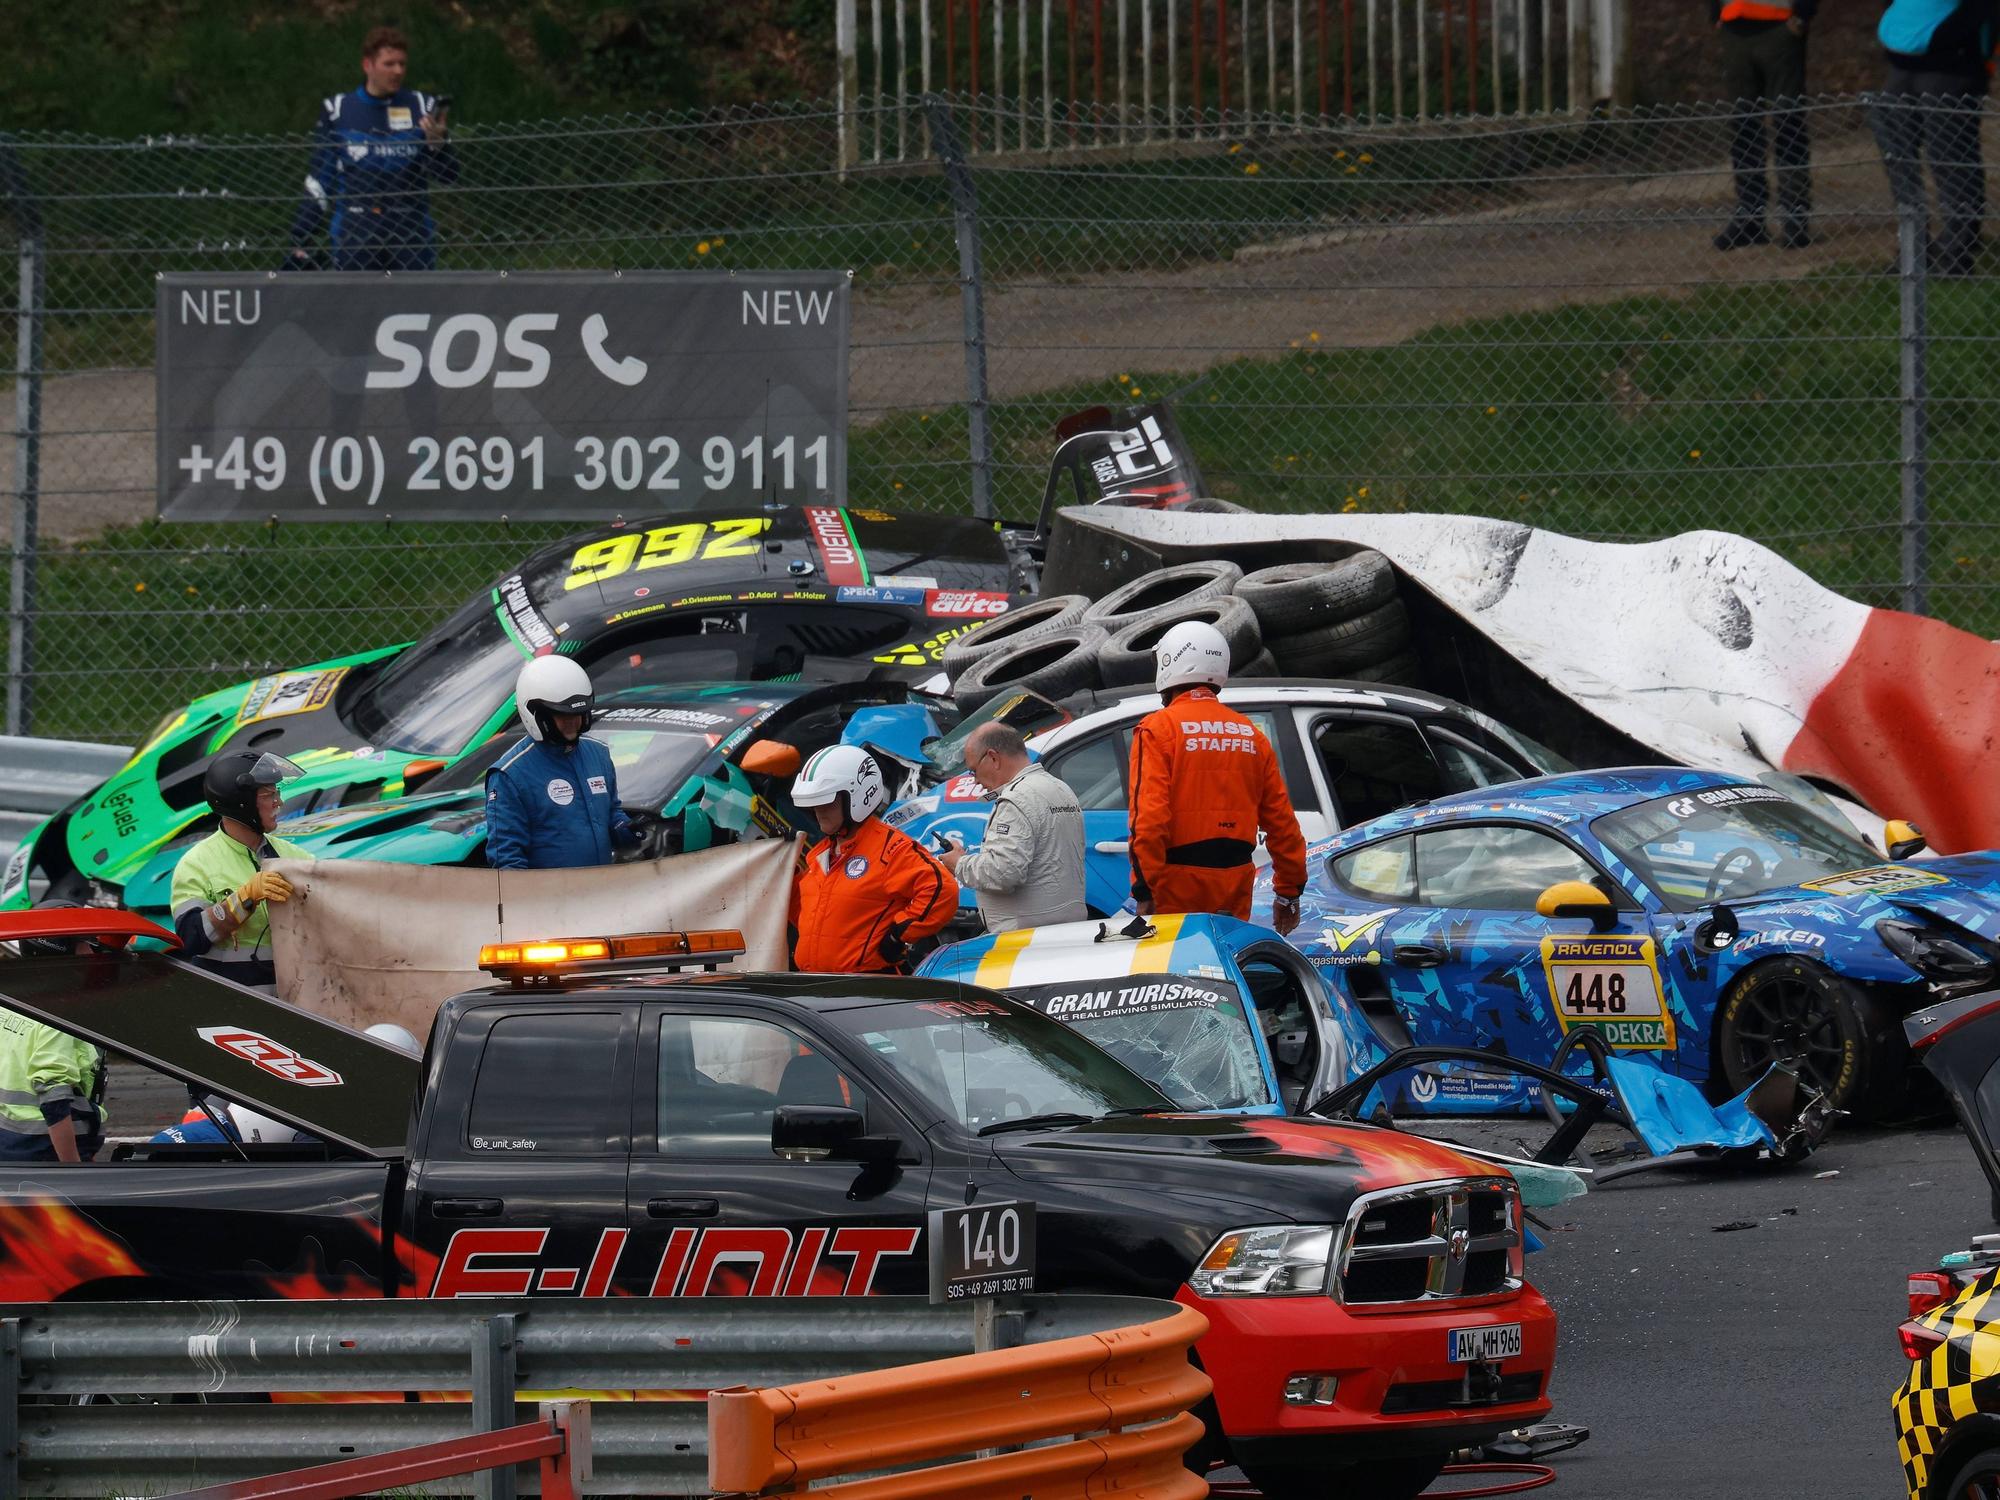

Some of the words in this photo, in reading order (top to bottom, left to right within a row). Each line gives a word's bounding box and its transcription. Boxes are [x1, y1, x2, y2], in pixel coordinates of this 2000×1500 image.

[181, 290, 261, 325] NEU
[742, 291, 832, 325] NEW
[365, 313, 559, 389] SOS
[179, 436, 287, 491] +49
[309, 435, 385, 505] (0)
[407, 436, 545, 491] 2691
[574, 435, 680, 491] 302
[702, 435, 829, 490] 9111
[811, 509, 855, 565] WEMPE
[563, 517, 773, 592] 992
[931, 599, 1010, 614] auto
[937, 592, 978, 602] sport
[1205, 649, 1223, 657] uvex
[1180, 720, 1255, 737] DMSB
[1185, 738, 1257, 755] STAFFEL
[1696, 789, 1740, 805] GRAN
[109, 792, 139, 838] eFuels
[1849, 871, 1917, 887] 448
[1557, 943, 1637, 956] RAVENOL
[1733, 929, 1826, 957] FALKEN
[1045, 990, 1111, 1015] GRAN
[1118, 983, 1219, 1006] TURISMO
[1566, 973, 1627, 1014] 448
[1726, 974, 1760, 1022] EAGLE
[1053, 1013, 1069, 1022] HE
[1072, 1011, 1101, 1020] REAL
[1103, 1006, 1148, 1018] DRIVING
[1150, 1000, 1215, 1011] SIMULATOR
[1605, 1023, 1668, 1044] DEKRA
[1835, 1039, 1855, 1097] GOOD
[958, 1208, 1020, 1271] 140
[947, 1284, 965, 1299] SOS
[966, 1282, 981, 1296] +49
[983, 1279, 1000, 1295] 2691
[1002, 1278, 1017, 1293] 302
[1019, 1276, 1033, 1290] 9111
[1458, 1332, 1476, 1359] AW
